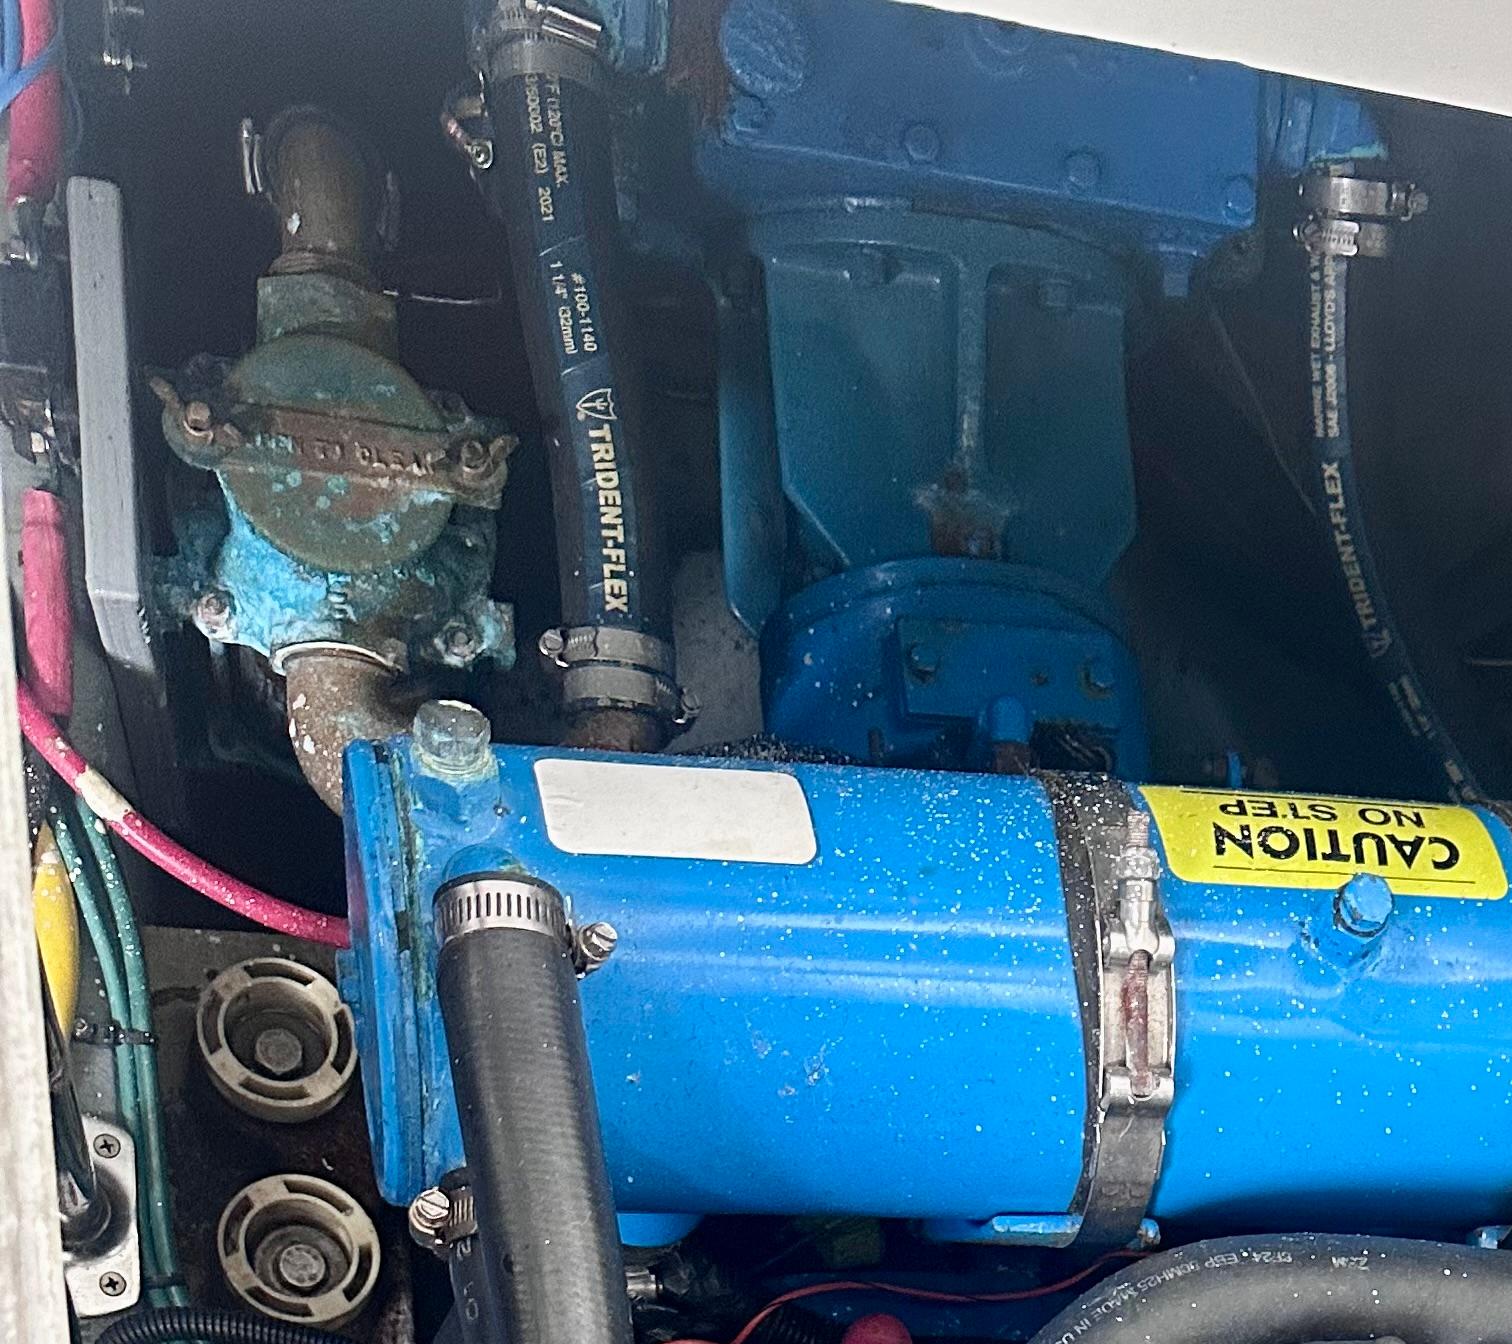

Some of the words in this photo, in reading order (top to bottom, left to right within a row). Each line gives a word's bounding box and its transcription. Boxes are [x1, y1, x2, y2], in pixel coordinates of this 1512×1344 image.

[537, 186, 555, 222] 2021
[570, 271, 597, 353] #100-1140
[588, 424, 629, 613] TRIDENT-FLEX
[1322, 461, 1378, 631] TRIDENT-FLEX
[1219, 798, 1339, 822] STEP
[1358, 806, 1425, 829] NO
[1211, 821, 1460, 870] CAUTION
[1072, 1317, 1093, 1336] IN
